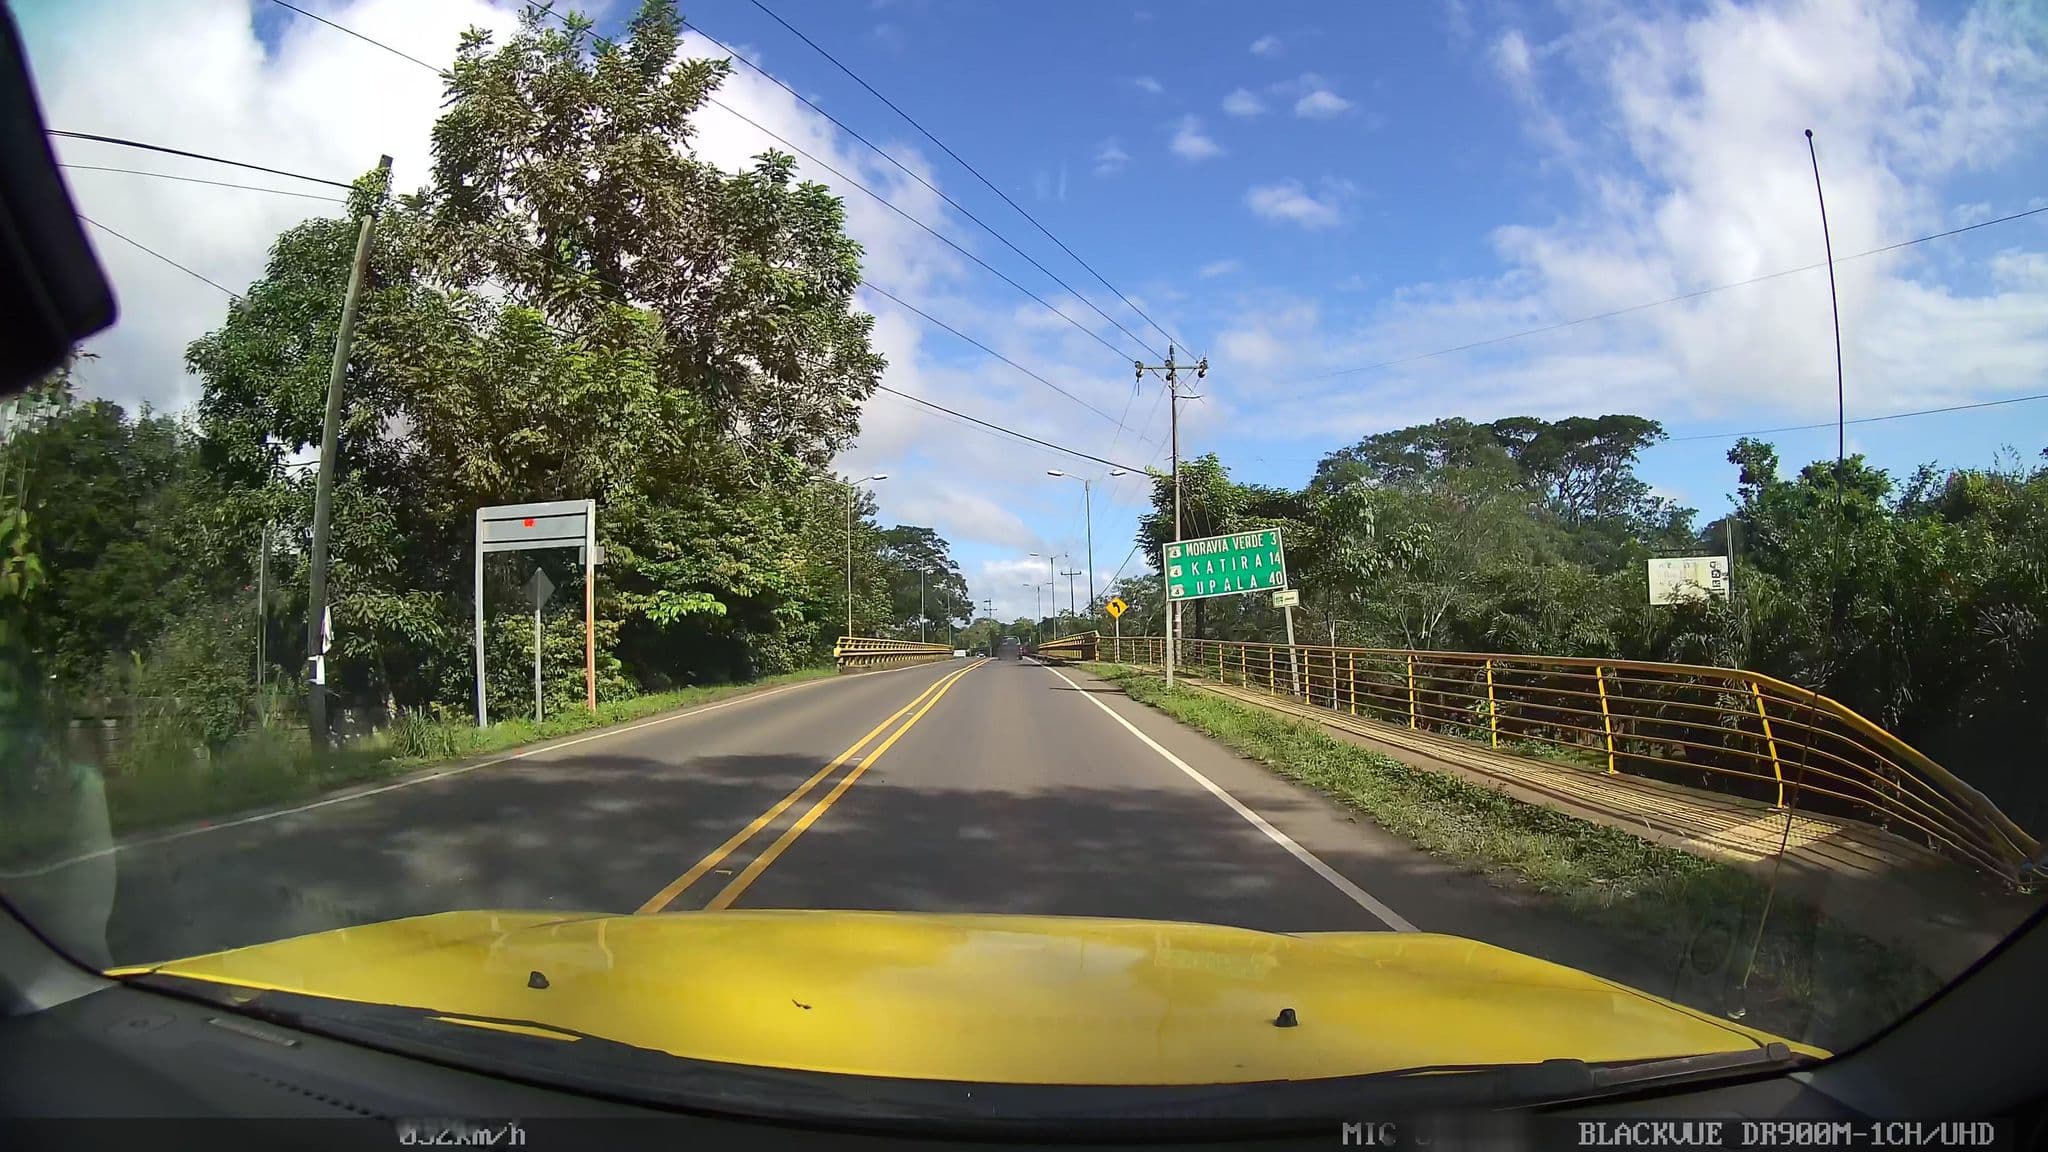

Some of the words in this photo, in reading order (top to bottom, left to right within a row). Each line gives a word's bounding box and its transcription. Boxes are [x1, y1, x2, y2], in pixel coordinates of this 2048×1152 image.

[1185, 538, 1229, 557] MORAVIA
[1232, 533, 1264, 550] VERDE
[1269, 532, 1277, 545] 3
[1191, 553, 1262, 577] KATIRA
[1269, 552, 1281, 566] 14
[1196, 574, 1258, 595] UPALA
[1269, 571, 1283, 586] 40
